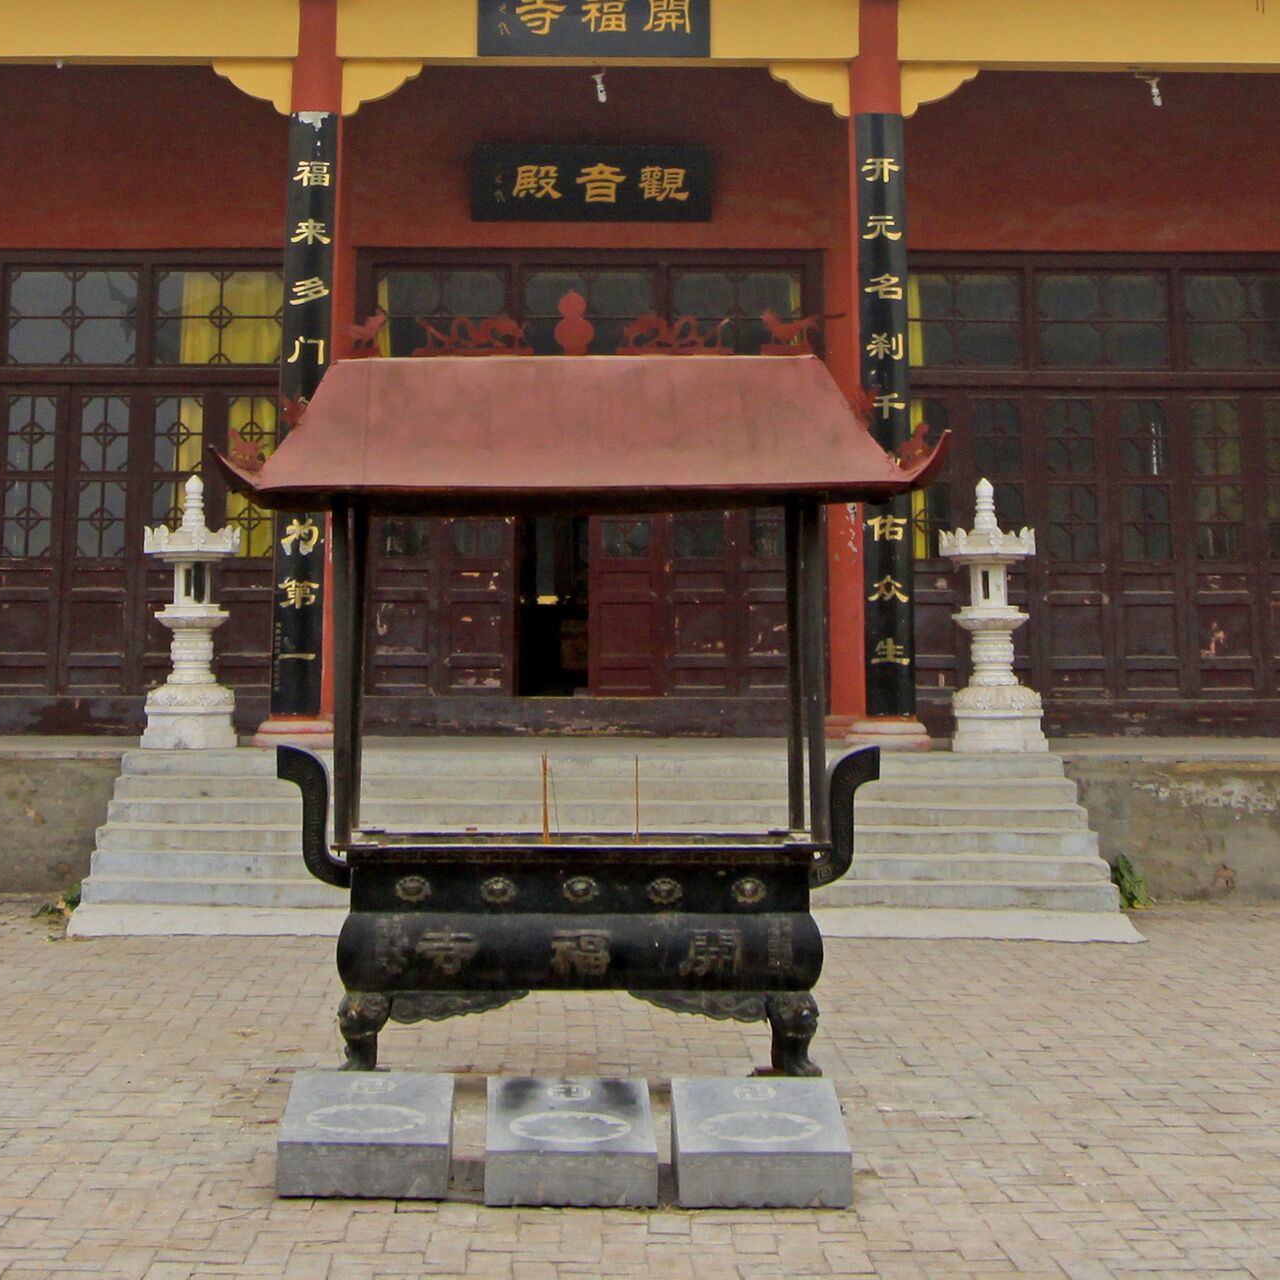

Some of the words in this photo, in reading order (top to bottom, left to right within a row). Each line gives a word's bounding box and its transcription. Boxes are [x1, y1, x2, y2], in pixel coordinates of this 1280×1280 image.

[512, 162, 690, 203] 觀音殿
[860, 157, 911, 666] 开元名刹千佑众生
